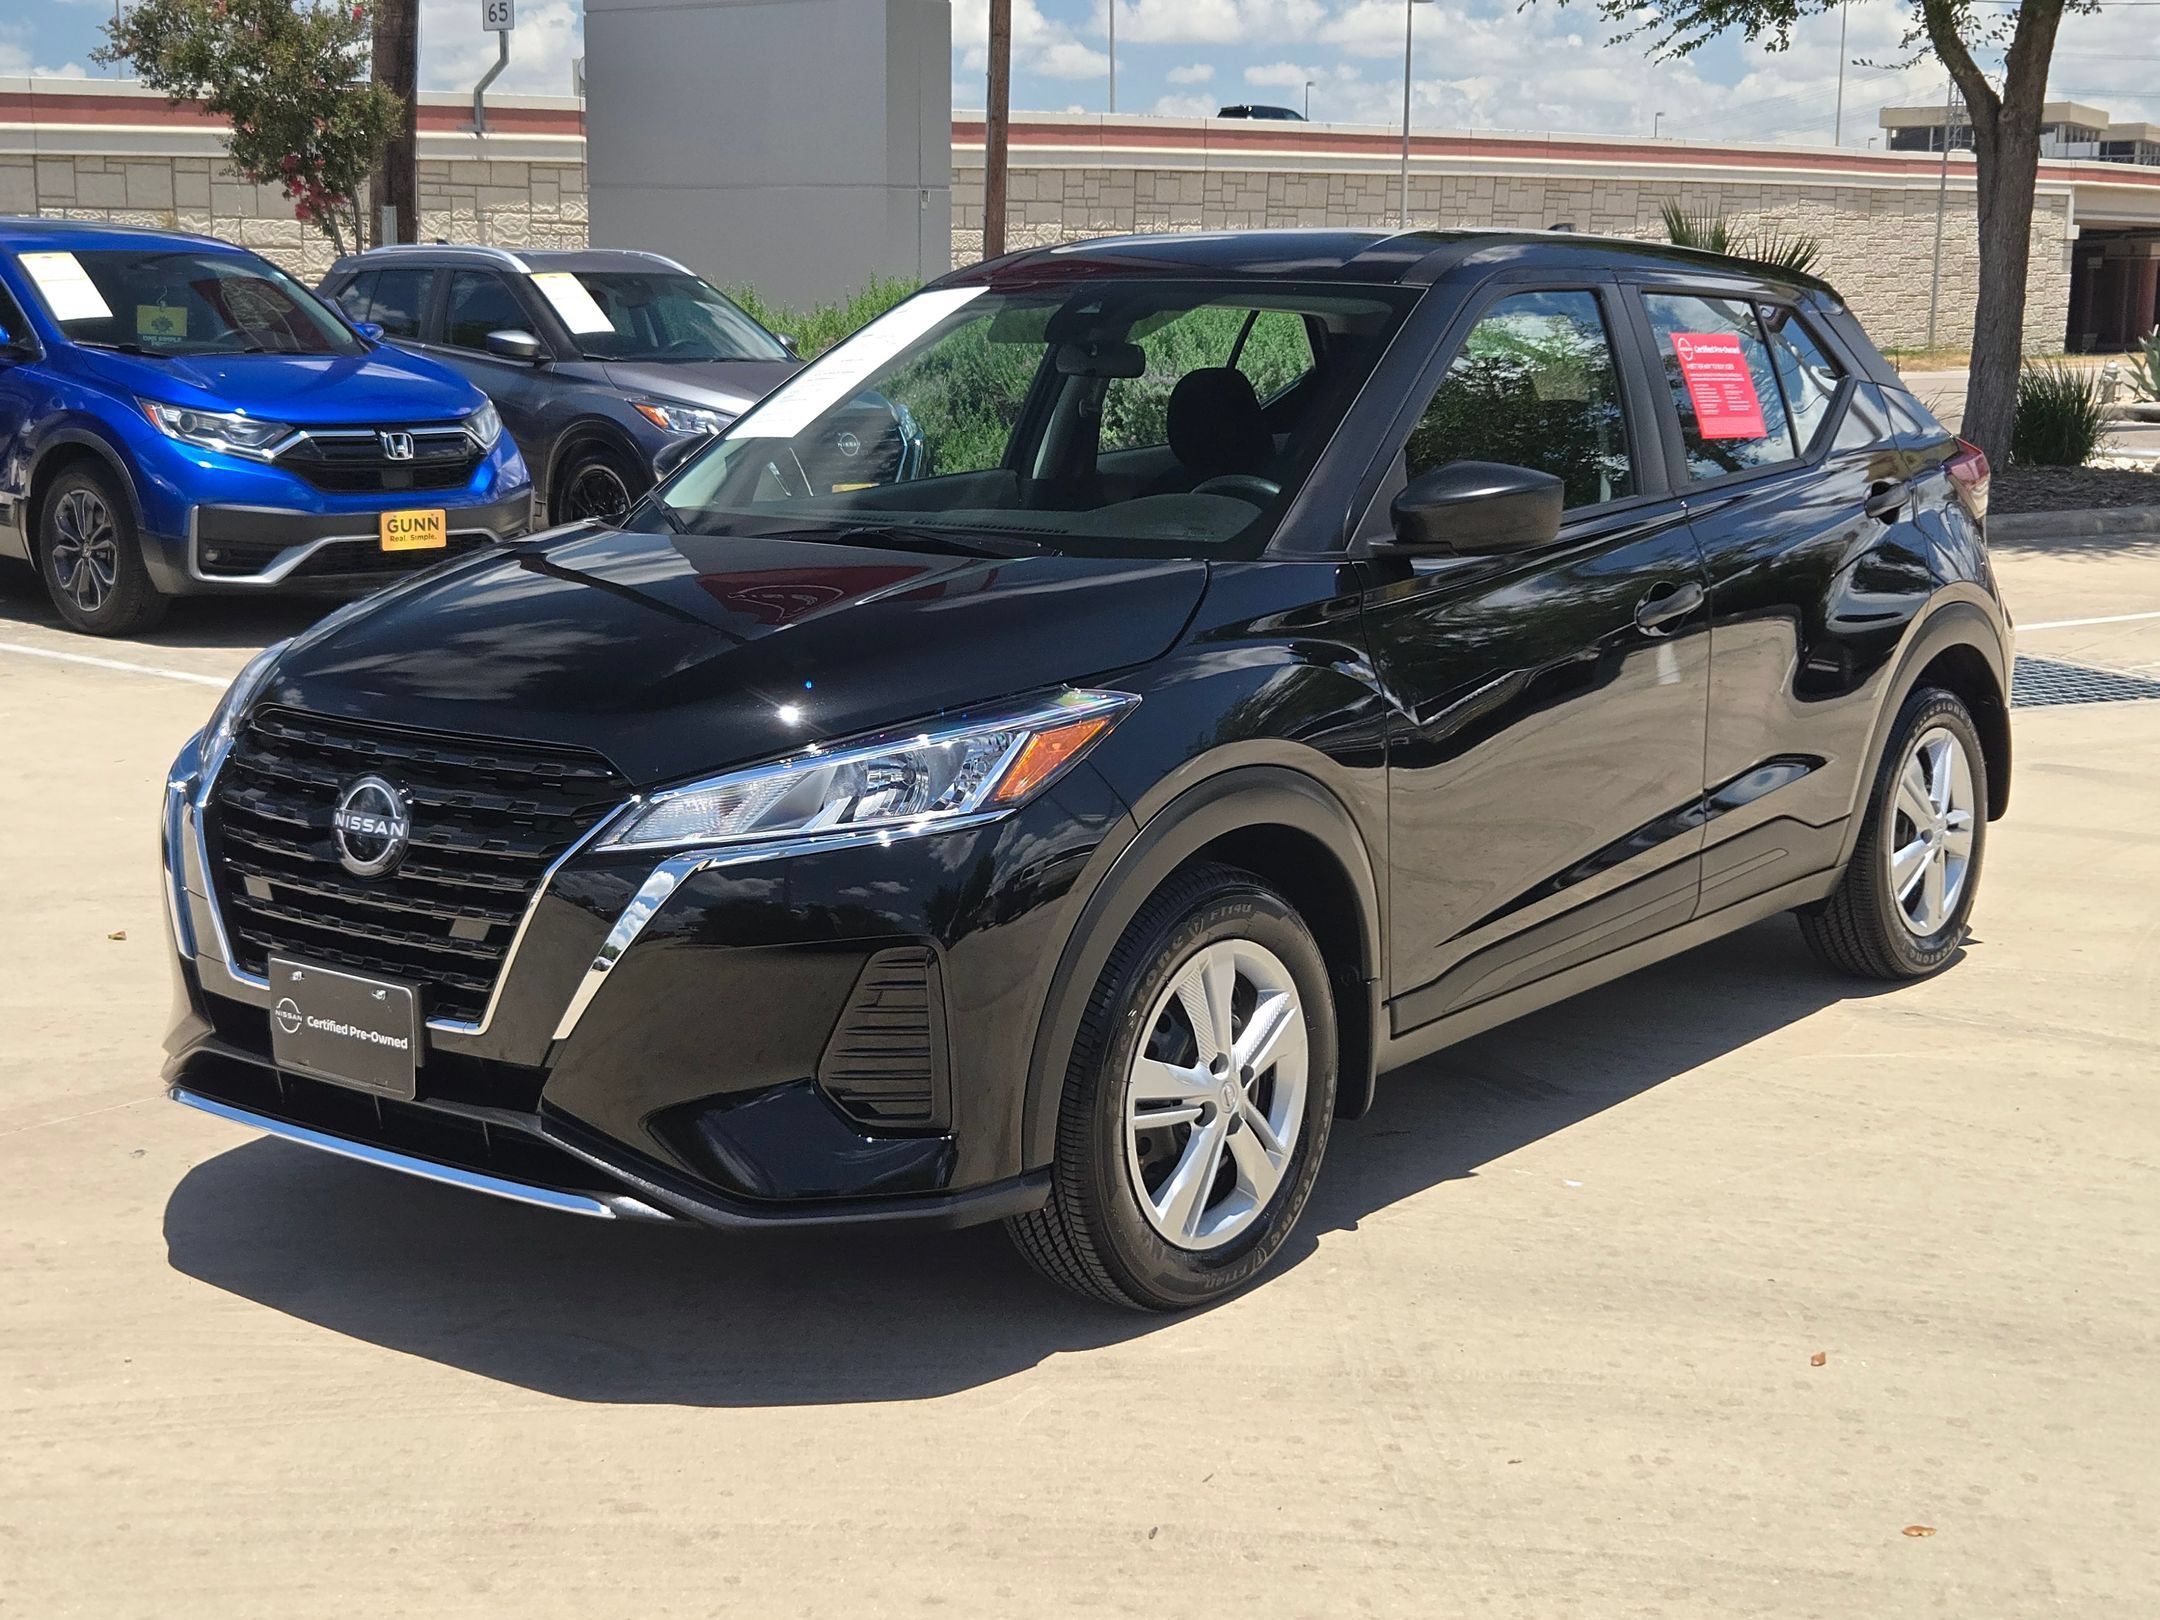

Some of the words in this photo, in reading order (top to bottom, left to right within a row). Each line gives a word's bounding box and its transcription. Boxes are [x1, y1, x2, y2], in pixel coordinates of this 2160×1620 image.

[488, 2, 508, 23] 65
[387, 516, 440, 534] GUNN
[335, 811, 405, 837] NISSAN
[274, 1009, 303, 1023] NISSAN
[306, 1015, 349, 1037] Certified
[349, 1025, 409, 1050] Pre-Owned
